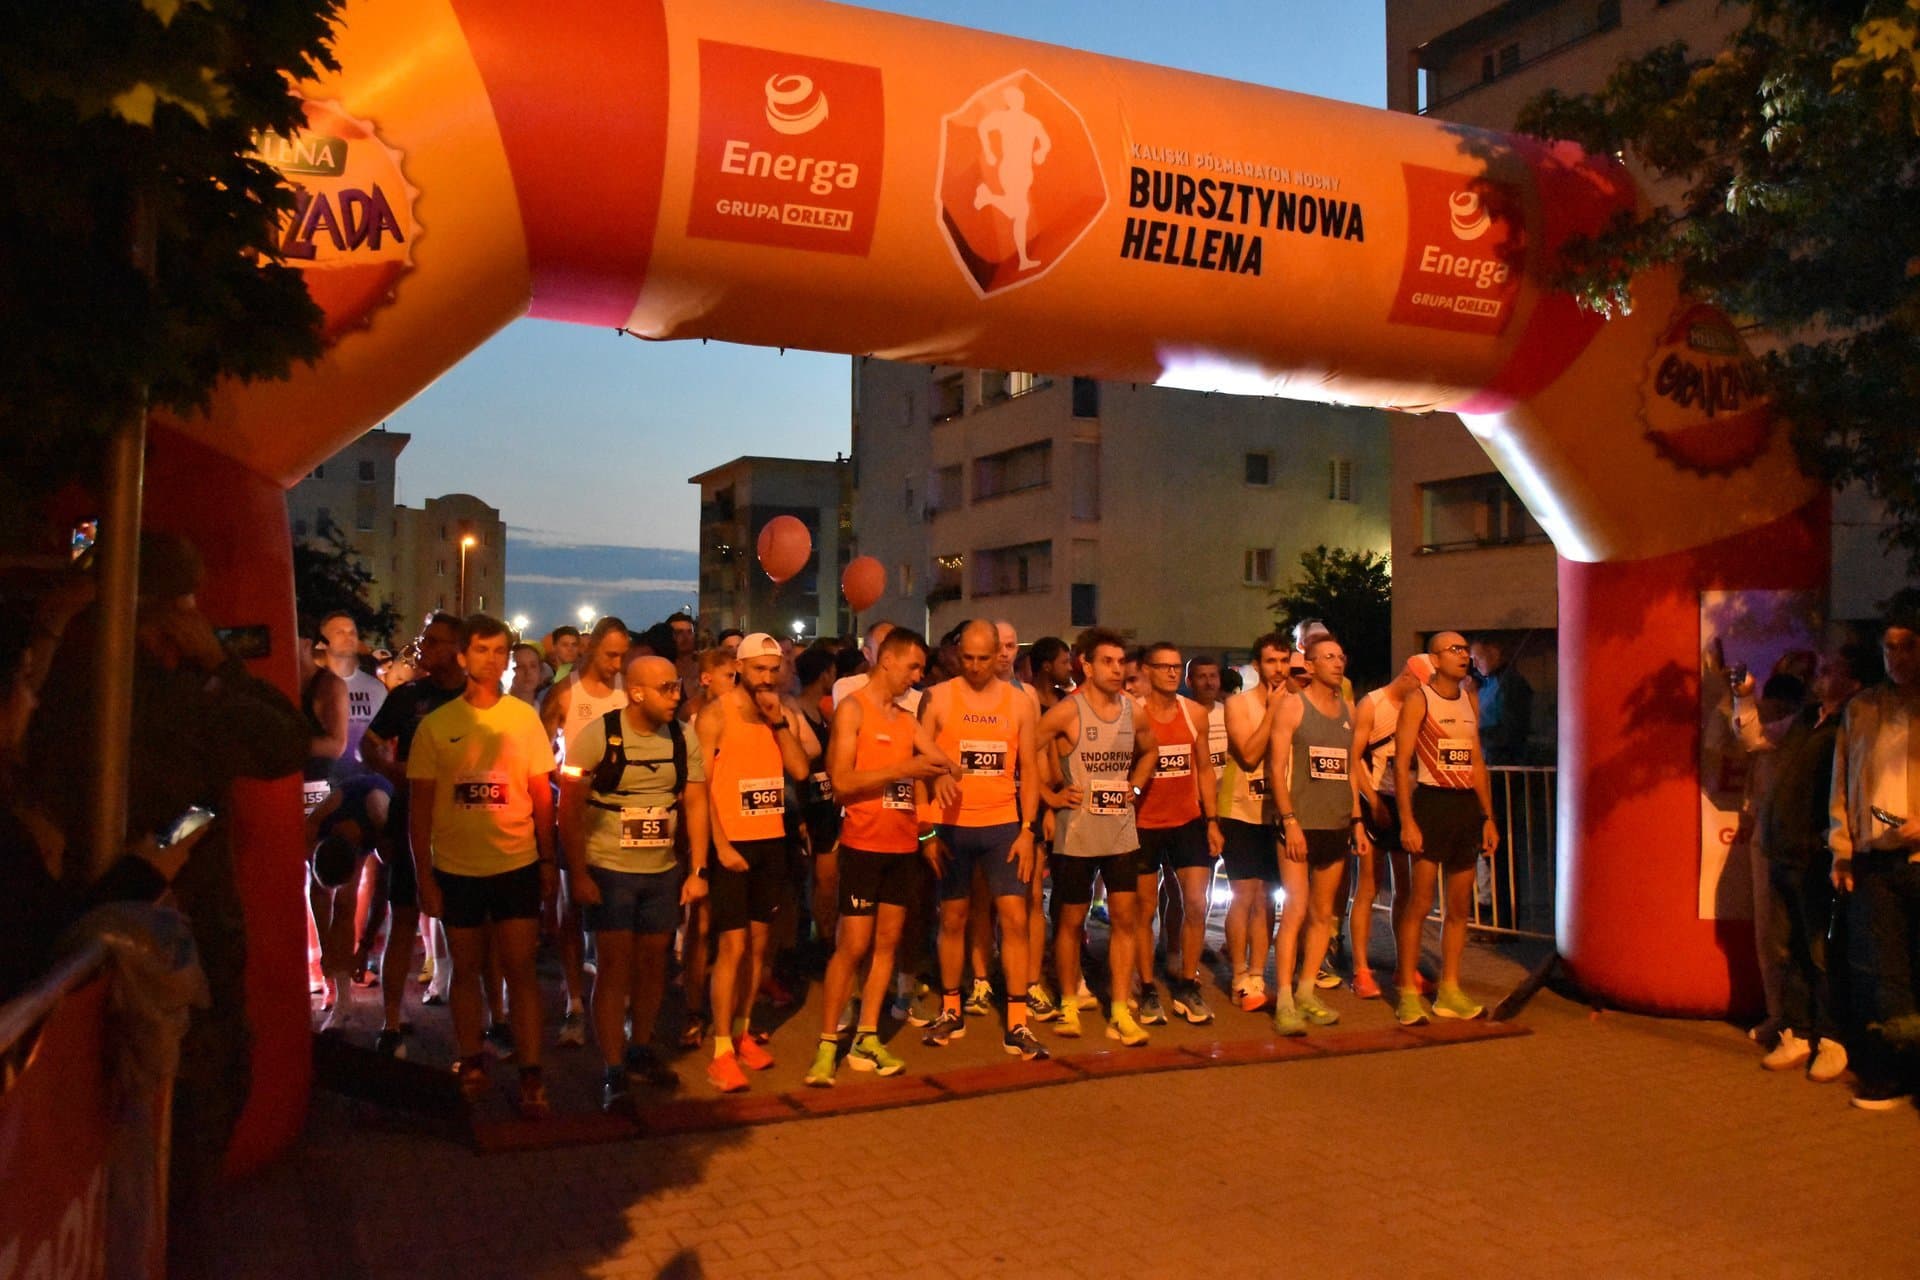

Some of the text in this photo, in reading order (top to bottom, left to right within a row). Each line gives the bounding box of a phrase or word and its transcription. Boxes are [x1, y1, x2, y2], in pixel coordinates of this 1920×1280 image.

[720, 139, 859, 196] Energa
[1131, 143, 1191, 166] KALISKI
[1295, 167, 1341, 192] NOCNY
[1129, 166, 1364, 242] BURSZTYNOWA
[716, 199, 850, 228] GRUPA ORLEN
[1120, 216, 1262, 276] HELLENA
[1419, 244, 1509, 289] Energa
[1411, 292, 1499, 315] GRUPA ORLEN
[963, 714, 997, 724] ADAM
[974, 753, 997, 766] 201
[1159, 755, 1185, 768] 948
[1449, 750, 1469, 761] 888
[1319, 758, 1341, 769] 983
[469, 785, 500, 798] 506
[752, 791, 777, 804] 966
[1102, 792, 1123, 804] 940
[641, 821, 661, 834] 55
